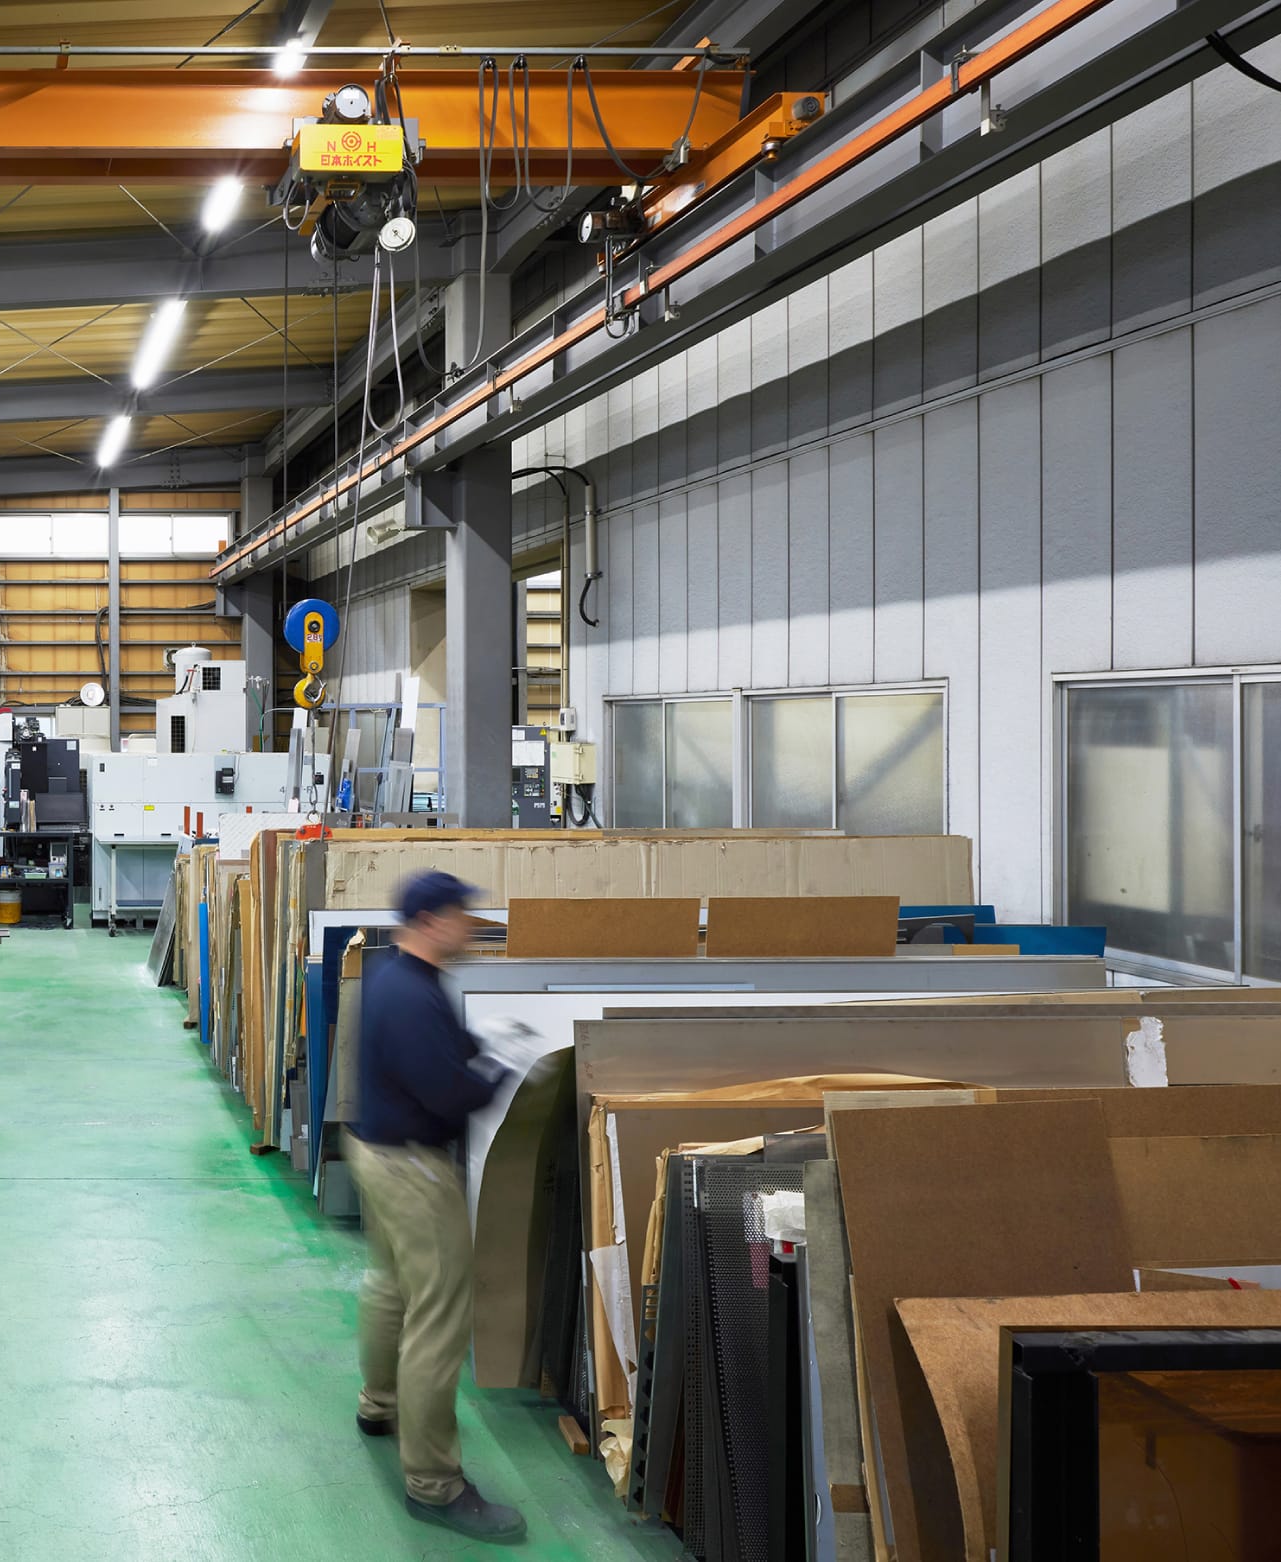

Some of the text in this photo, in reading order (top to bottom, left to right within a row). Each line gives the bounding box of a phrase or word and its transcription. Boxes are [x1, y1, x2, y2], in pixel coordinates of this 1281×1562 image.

[327, 141, 377, 152] N H
[321, 154, 382, 167] 日本ホイスト
